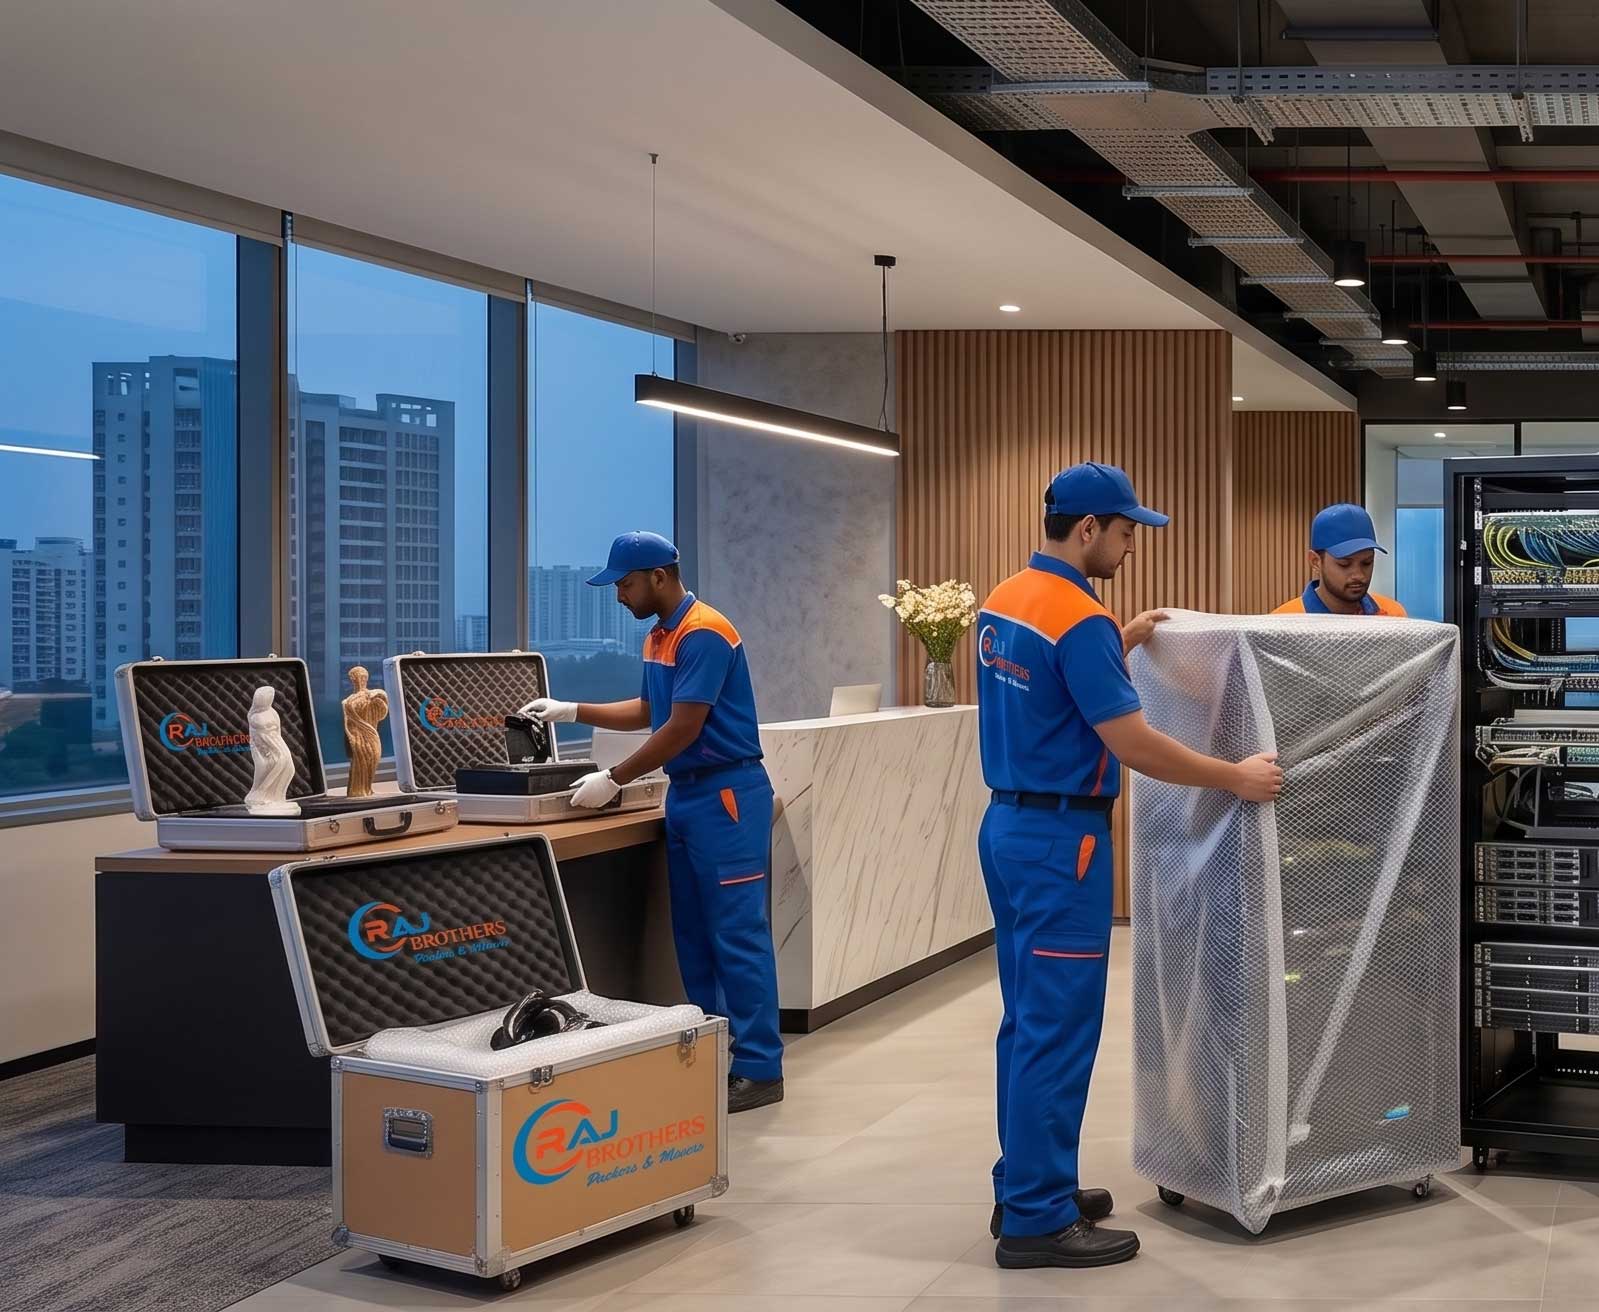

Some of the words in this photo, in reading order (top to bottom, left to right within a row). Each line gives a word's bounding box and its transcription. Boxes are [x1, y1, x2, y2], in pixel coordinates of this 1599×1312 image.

[364, 912, 431, 942] RAJ
[410, 920, 507, 951] BROTHERS
[535, 1109, 618, 1160] RAJ
[586, 1115, 705, 1169] BROTHERS
[642, 1155, 654, 1169] &
